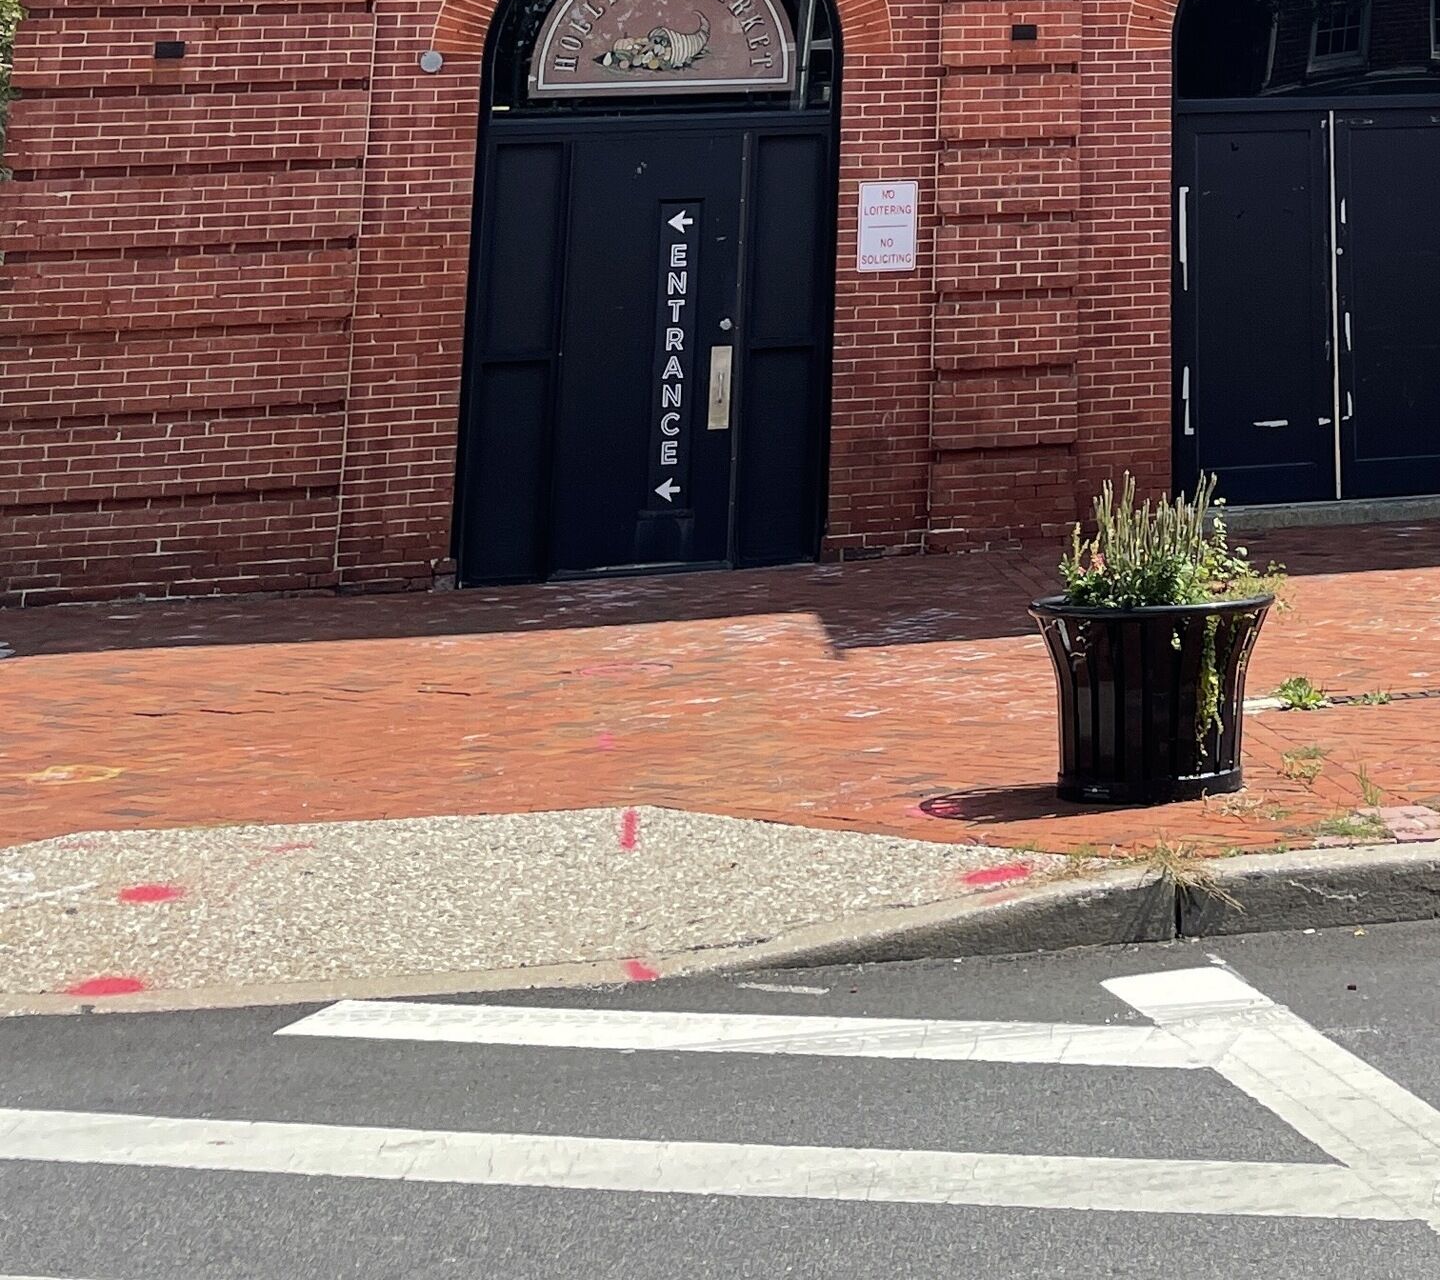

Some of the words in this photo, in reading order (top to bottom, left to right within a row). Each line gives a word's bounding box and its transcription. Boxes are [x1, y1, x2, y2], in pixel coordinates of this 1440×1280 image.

[882, 190, 895, 200] NO
[864, 205, 912, 216] LOITERING
[880, 238, 894, 248] NO
[861, 253, 912, 265] SOLICITING
[660, 243, 688, 466] ENTRANCE
